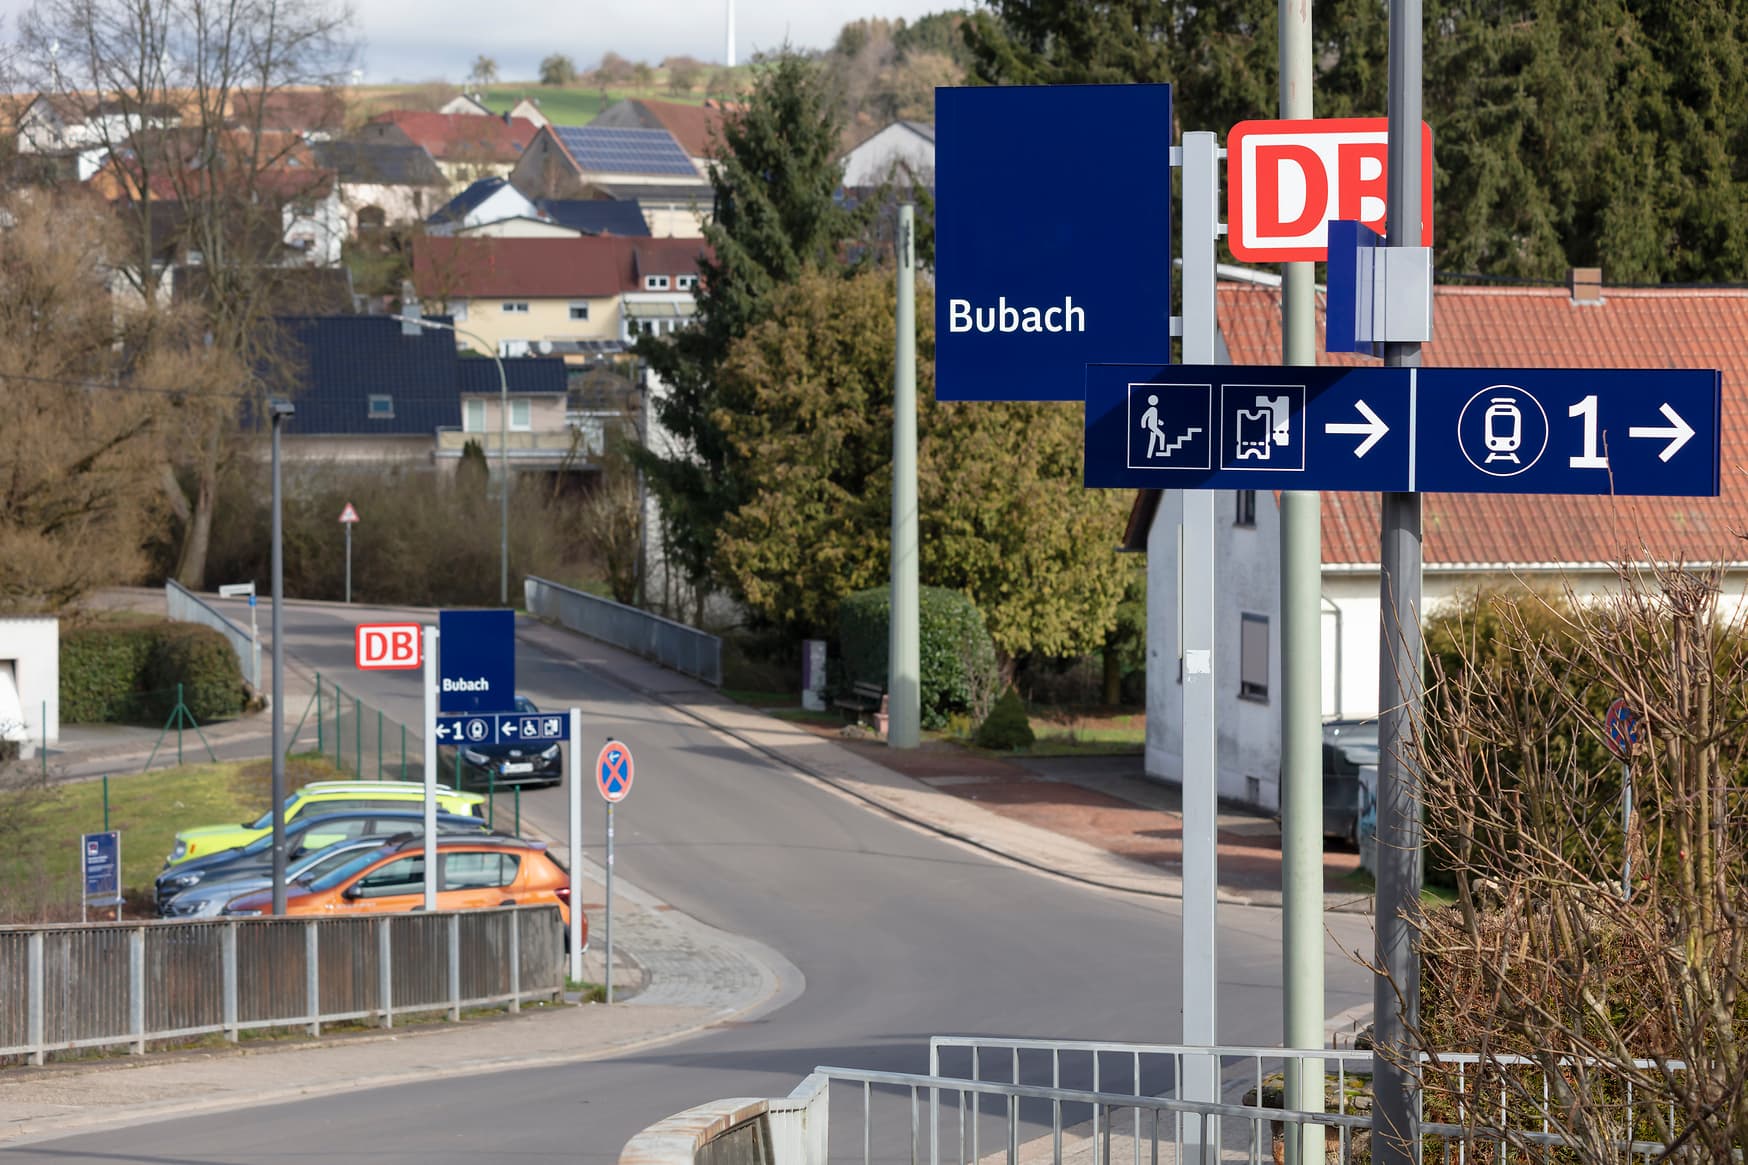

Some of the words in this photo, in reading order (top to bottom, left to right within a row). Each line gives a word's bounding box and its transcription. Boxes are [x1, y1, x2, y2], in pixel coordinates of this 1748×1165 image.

[1255, 142, 1388, 238] DB
[949, 296, 1085, 333] Bubach
[1568, 394, 1609, 469] 1
[365, 631, 414, 661] DB
[442, 677, 489, 692] Bubach
[452, 721, 465, 740] 1
